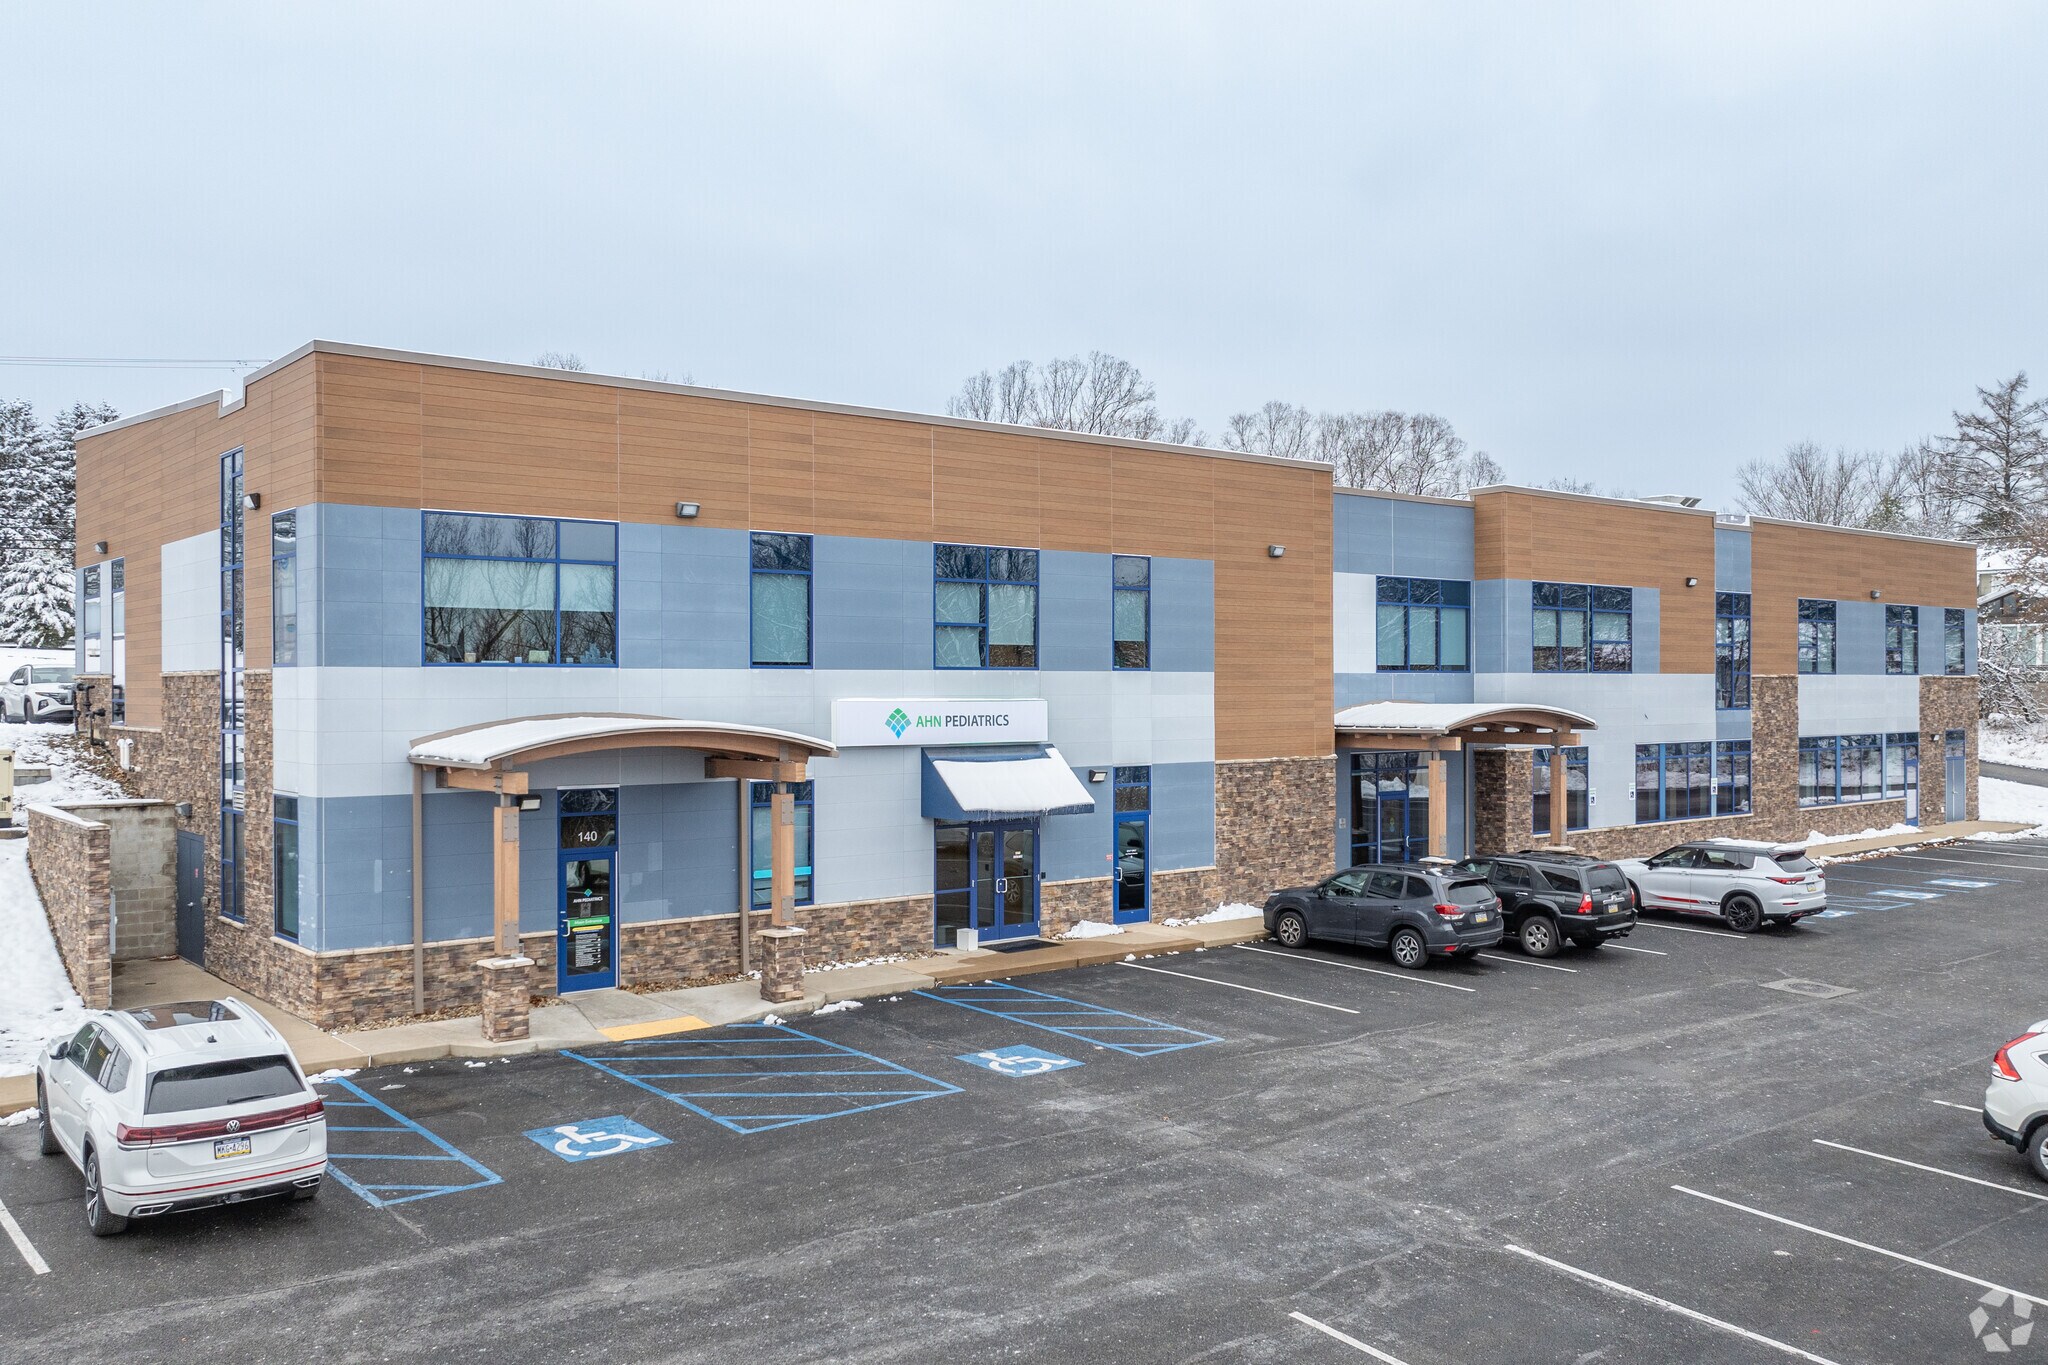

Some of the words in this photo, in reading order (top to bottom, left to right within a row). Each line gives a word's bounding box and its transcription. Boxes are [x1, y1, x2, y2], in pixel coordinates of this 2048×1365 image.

[916, 715, 941, 727] AHN
[945, 714, 1009, 727] PEDIATRICS
[578, 831, 597, 842] 140
